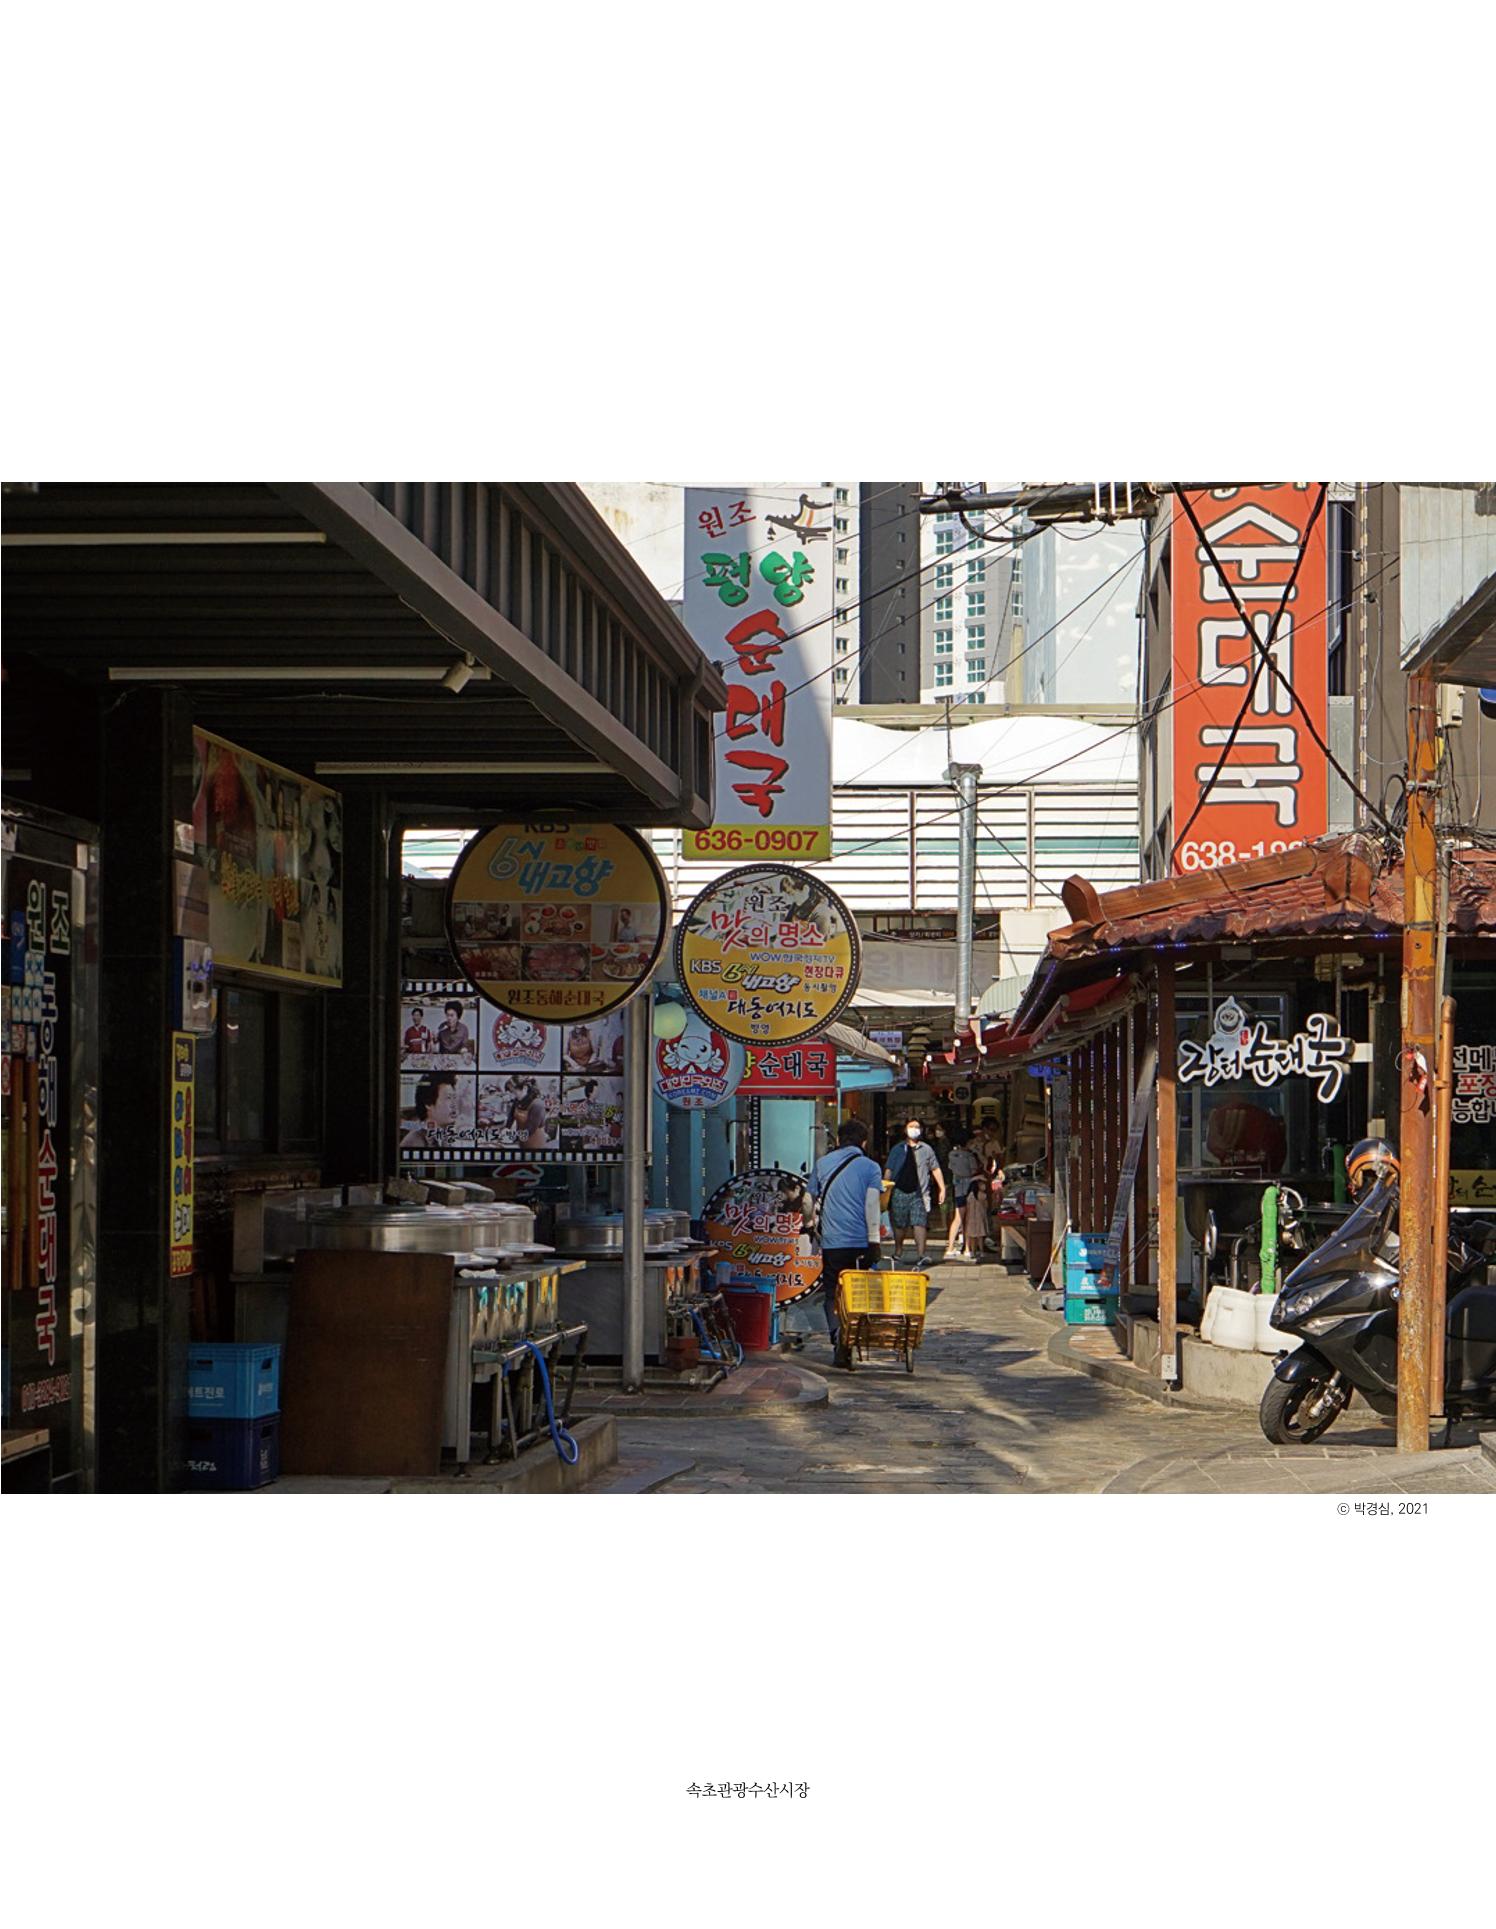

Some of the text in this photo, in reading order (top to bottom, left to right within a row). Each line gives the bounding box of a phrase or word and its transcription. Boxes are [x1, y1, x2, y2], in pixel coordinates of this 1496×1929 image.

[697, 500, 758, 540] 원조
[700, 551, 815, 608] 평양
[724, 608, 790, 819] 순대국
[694, 829, 819, 853] 636-0907
[517, 855, 615, 898] 내고향
[748, 894, 789, 914] 원조
[778, 922, 826, 949] 명소
[690, 960, 723, 975] KBS
[750, 952, 781, 962] WOW
[741, 974, 802, 994] 내고향
[803, 965, 845, 980] 현장다큐
[727, 997, 819, 1020] 대동여지도
[757, 1050, 829, 1080] 순대국
[1243, 1009, 1347, 1104] 순대국
